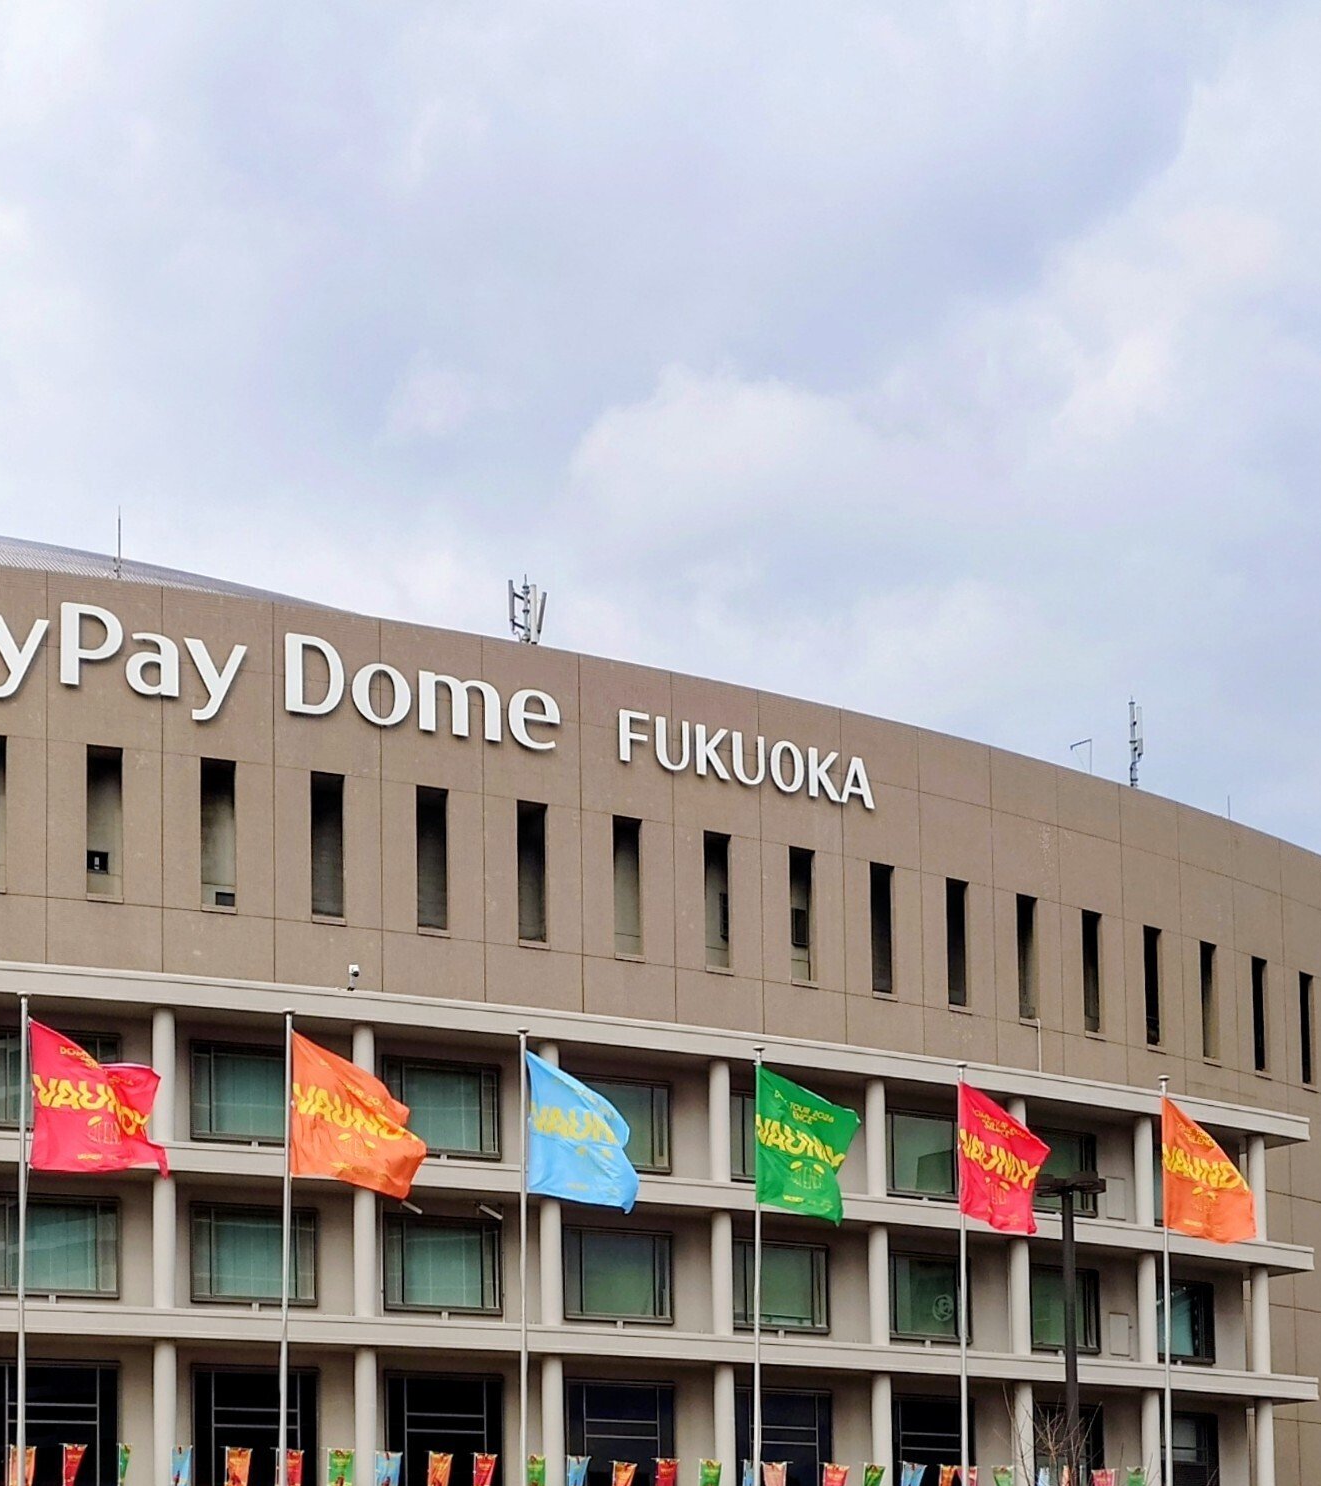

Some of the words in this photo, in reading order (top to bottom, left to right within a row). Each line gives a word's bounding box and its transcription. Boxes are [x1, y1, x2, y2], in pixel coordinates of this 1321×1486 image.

[283, 631, 562, 752] Dome
[616, 706, 876, 811] FUKUOKA
[292, 1083, 419, 1141] VAUND
